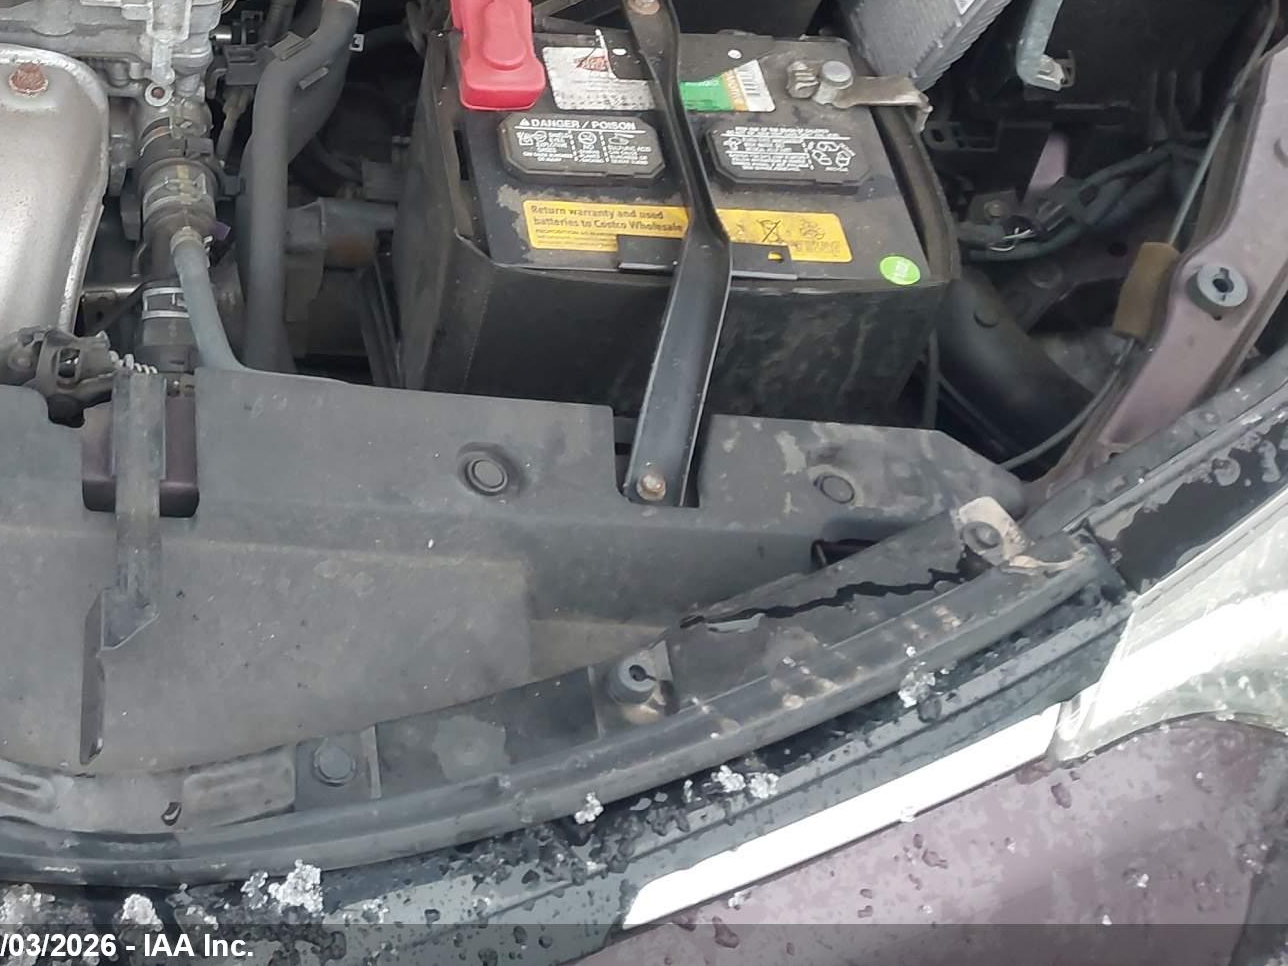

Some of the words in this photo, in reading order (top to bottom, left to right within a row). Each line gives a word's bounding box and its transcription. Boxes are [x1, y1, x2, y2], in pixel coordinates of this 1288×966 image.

[531, 119, 580, 129] DANGER
[591, 121, 637, 131] POISON
[531, 205, 567, 215] Return
[569, 208, 615, 219] warranty
[617, 210, 637, 218] and
[639, 211, 664, 220] used
[533, 217, 578, 227] batteries
[581, 219, 592, 228] to
[594, 219, 627, 229] Costco
[630, 221, 683, 232] Wholesale
